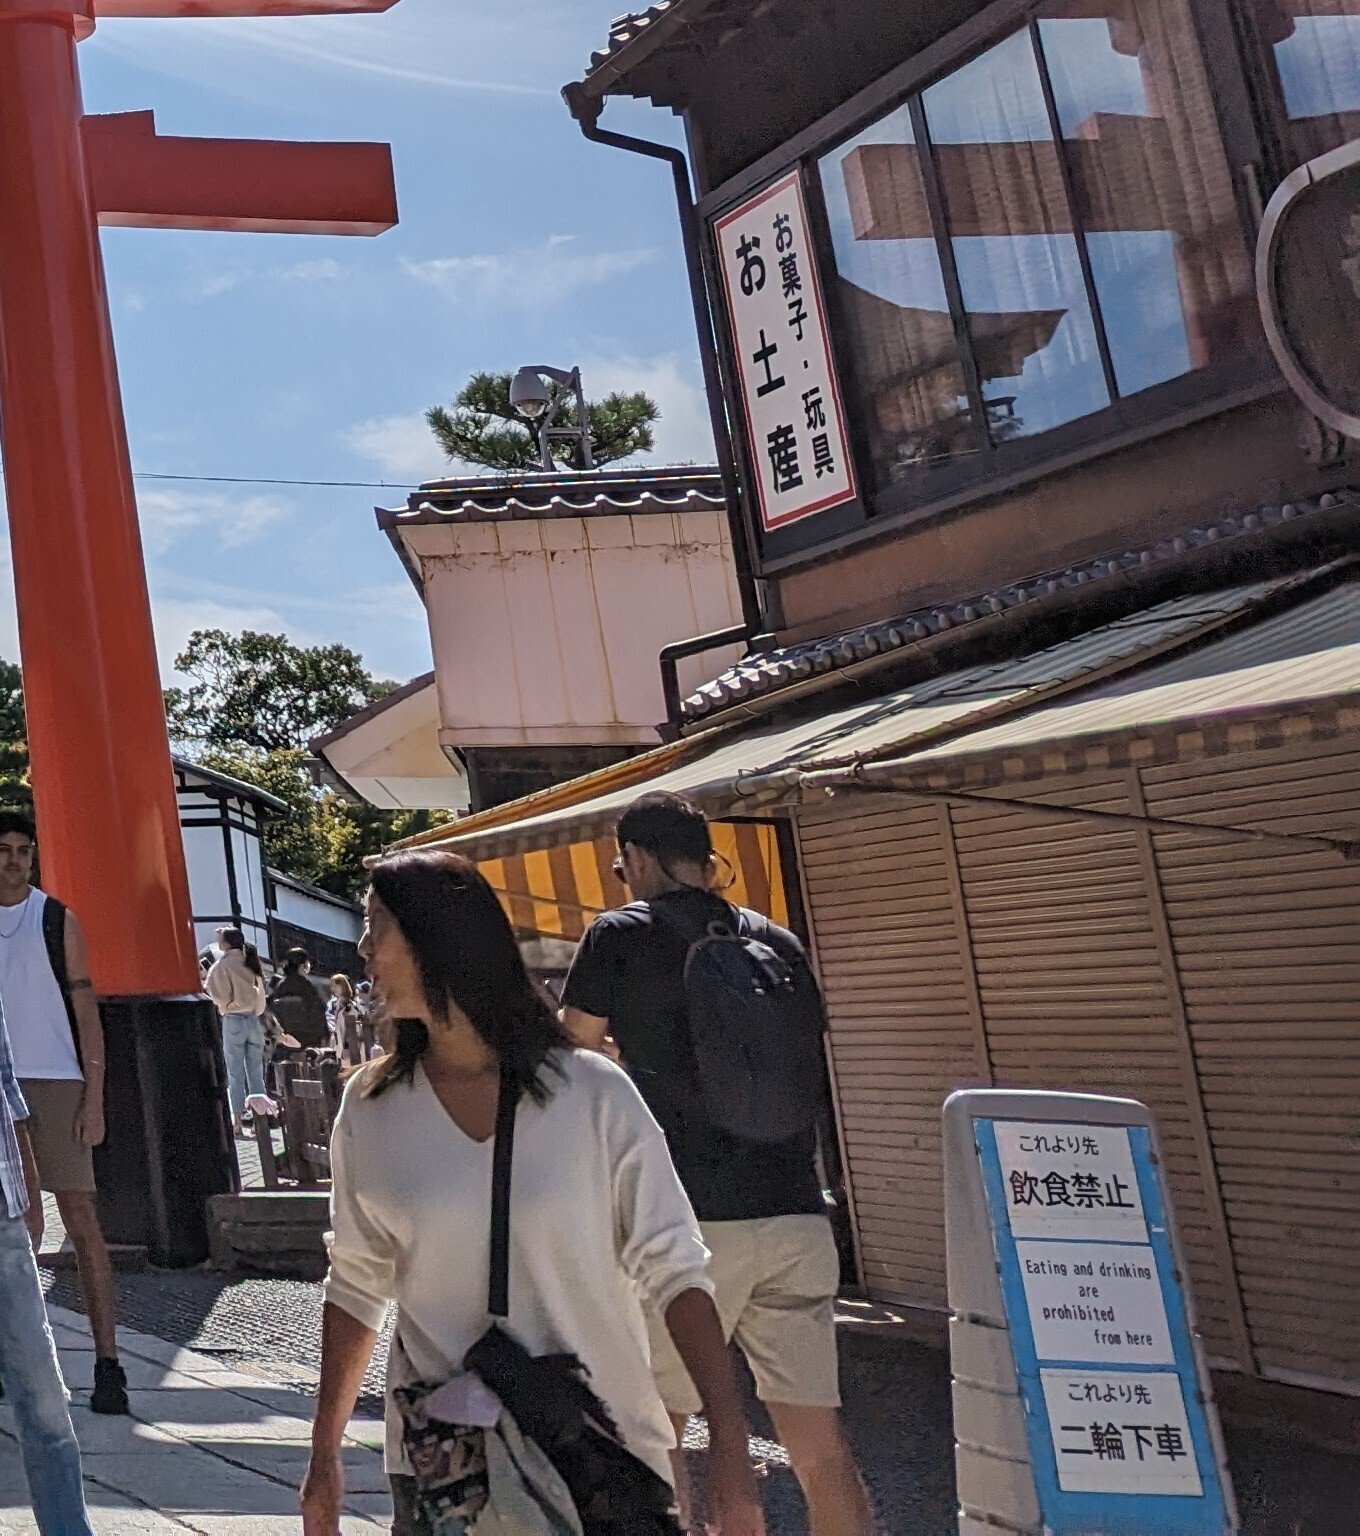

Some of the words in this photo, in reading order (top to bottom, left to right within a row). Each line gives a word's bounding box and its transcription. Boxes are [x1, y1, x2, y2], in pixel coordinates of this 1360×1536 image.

[773, 213, 834, 479] お菓子・玩具
[735, 233, 804, 495] お土産
[1019, 1135, 1099, 1156] これより先
[1009, 1170, 1135, 1208] 飲食禁止
[1025, 1260, 1067, 1276] Eating
[1074, 1261, 1094, 1276] and
[1100, 1262, 1151, 1280] drinking
[1078, 1286, 1099, 1298] are
[1042, 1304, 1115, 1322] prohibited
[1094, 1329, 1121, 1345] from
[1126, 1331, 1153, 1346] here
[1069, 1383, 1152, 1405] これより先
[1061, 1422, 1187, 1461] 二輪下車
